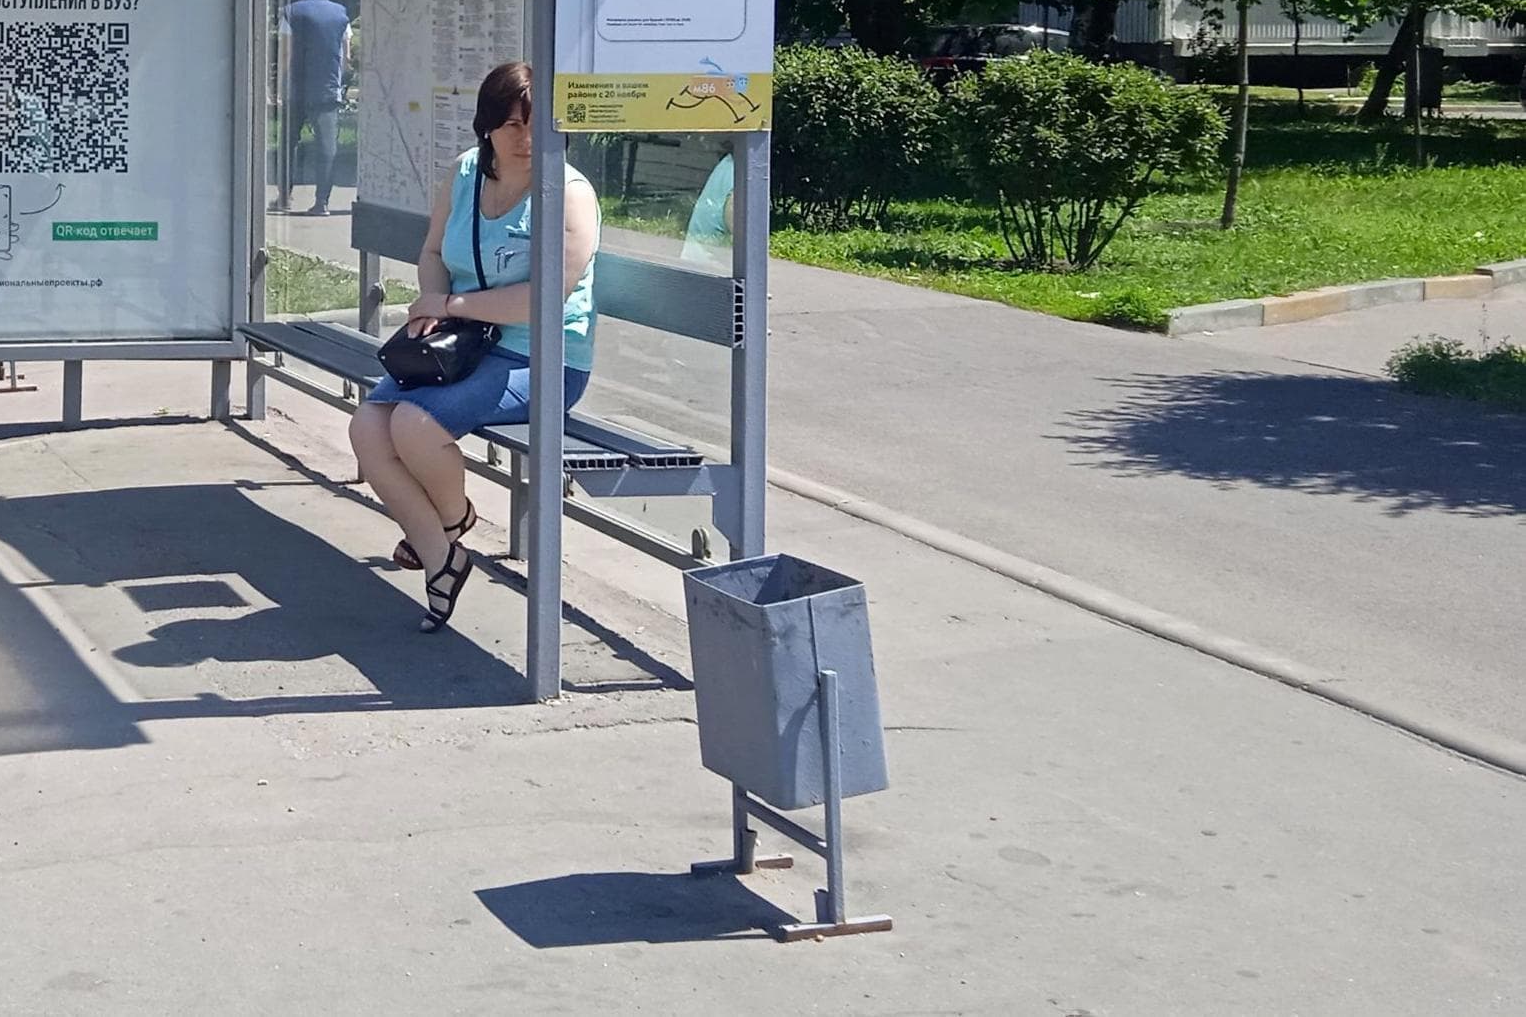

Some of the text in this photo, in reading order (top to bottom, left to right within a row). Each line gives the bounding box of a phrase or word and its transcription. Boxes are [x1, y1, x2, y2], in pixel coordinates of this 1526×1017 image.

[693, 83, 715, 93] м86
[604, 90, 615, 98] 20
[100, 226, 154, 236] отвечает
